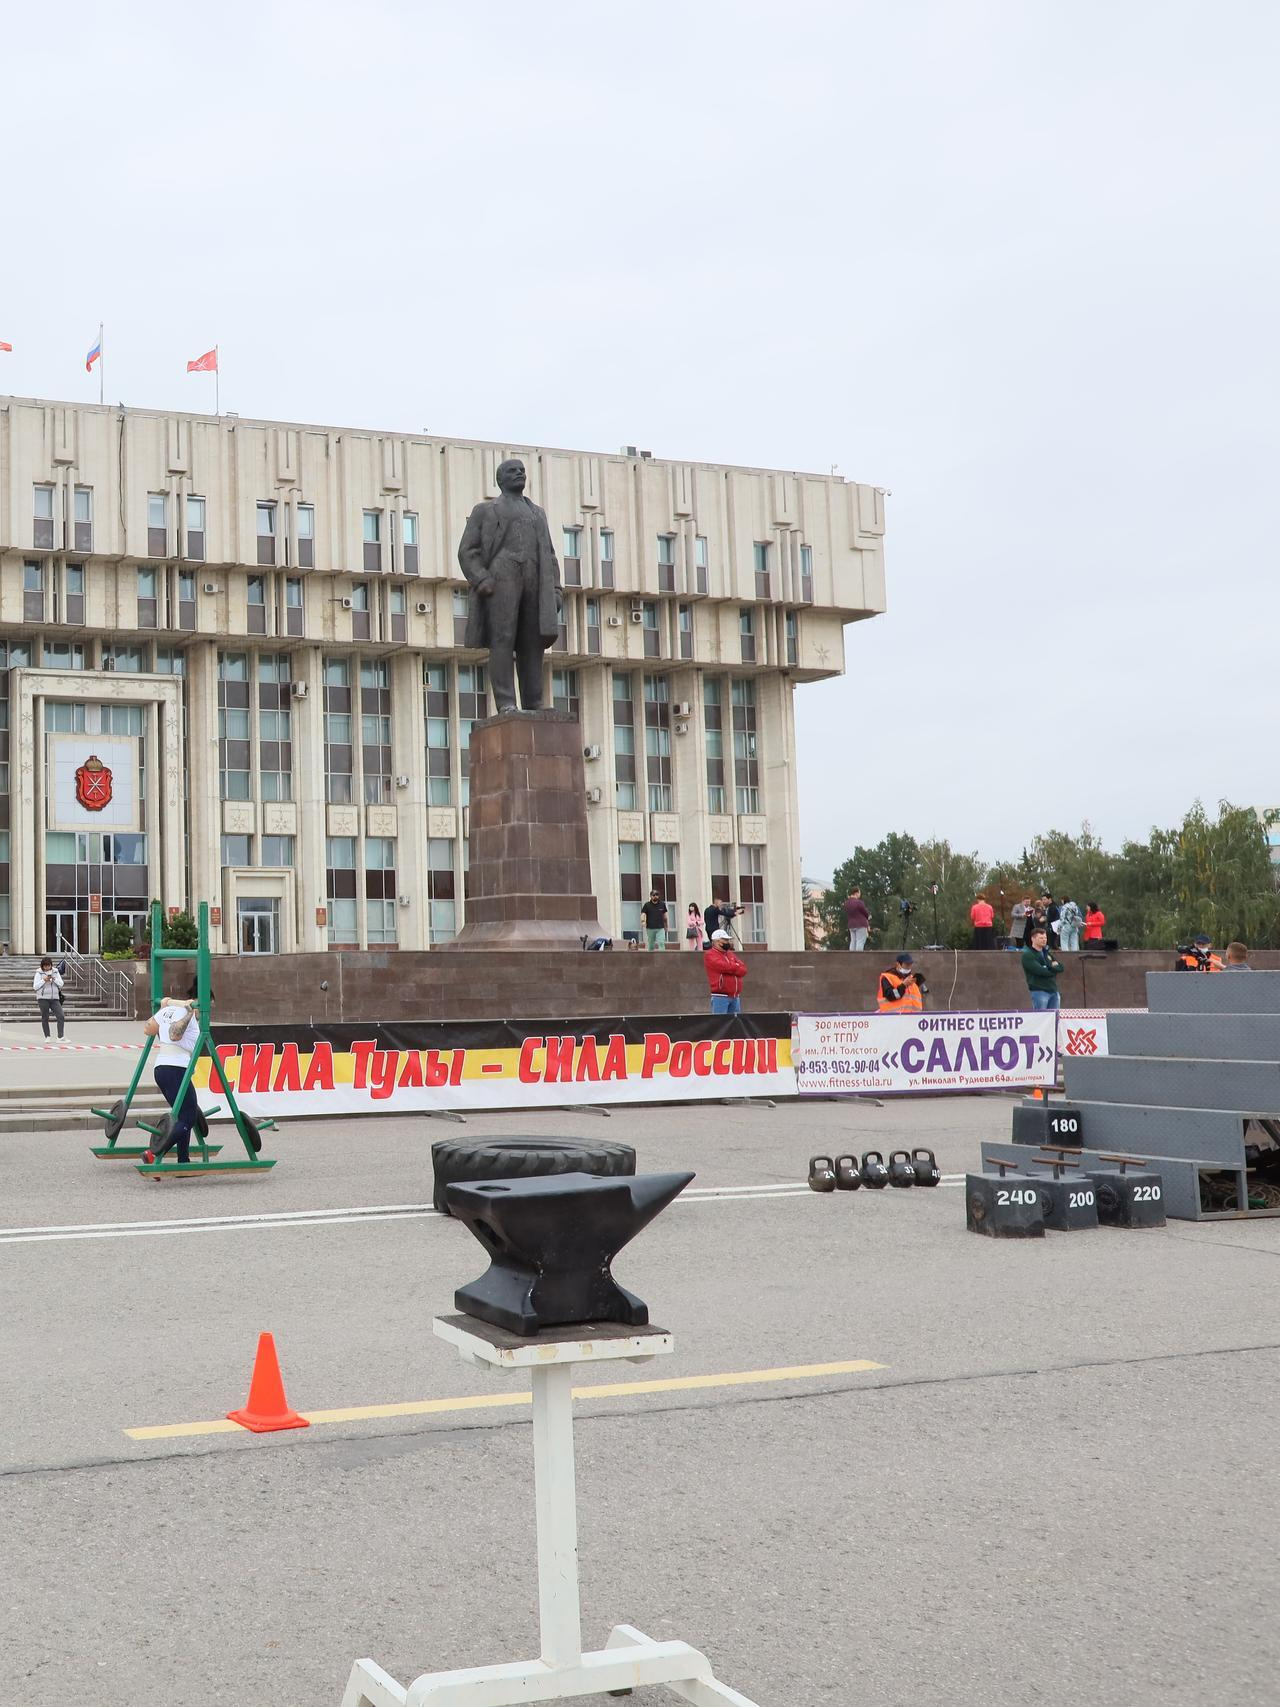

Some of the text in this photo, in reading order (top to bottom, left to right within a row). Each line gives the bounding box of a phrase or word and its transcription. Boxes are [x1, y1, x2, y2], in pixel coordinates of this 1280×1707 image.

[815, 1021, 870, 1031] 300 метров
[918, 1017, 1024, 1032] ФИТНЕС ЦЕНТР
[820, 1033, 859, 1043] от ТГПУ
[840, 1047, 878, 1055] Толстого
[881, 1035, 1053, 1073] «САЛЮТ»
[208, 1041, 336, 1094] СИЛА
[350, 1039, 466, 1100] Тулы
[519, 1034, 628, 1084] СИЛА
[641, 1032, 778, 1079] России
[800, 1060, 880, 1074] 8-953-962-90-04
[800, 1076, 892, 1088] www.fitness-tula.ru
[909, 1078, 920, 1087] ул.
[921, 1076, 957, 1085] Николая
[959, 1075, 994, 1085] Руднева
[1051, 1118, 1078, 1133] 180
[996, 1189, 1037, 1206] 240
[1069, 1191, 1094, 1208] 200
[1133, 1185, 1161, 1202] 220
